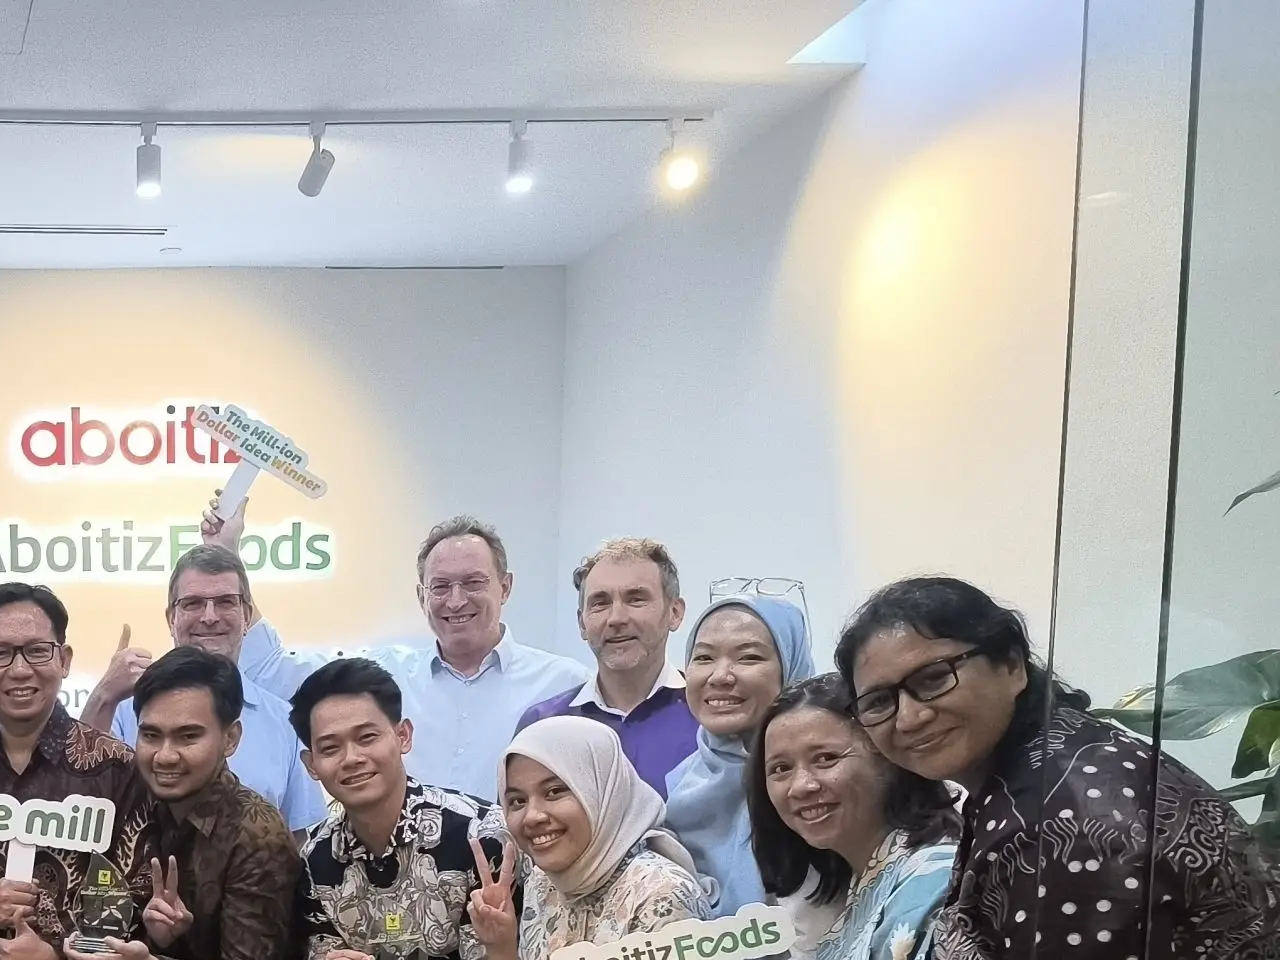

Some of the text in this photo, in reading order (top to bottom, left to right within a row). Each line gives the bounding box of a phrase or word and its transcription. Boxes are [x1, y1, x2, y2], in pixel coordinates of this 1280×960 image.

[196, 410, 321, 491] Dollar Idea Winner
[225, 411, 303, 464] The Mill-ion
[25, 805, 106, 843] mill
